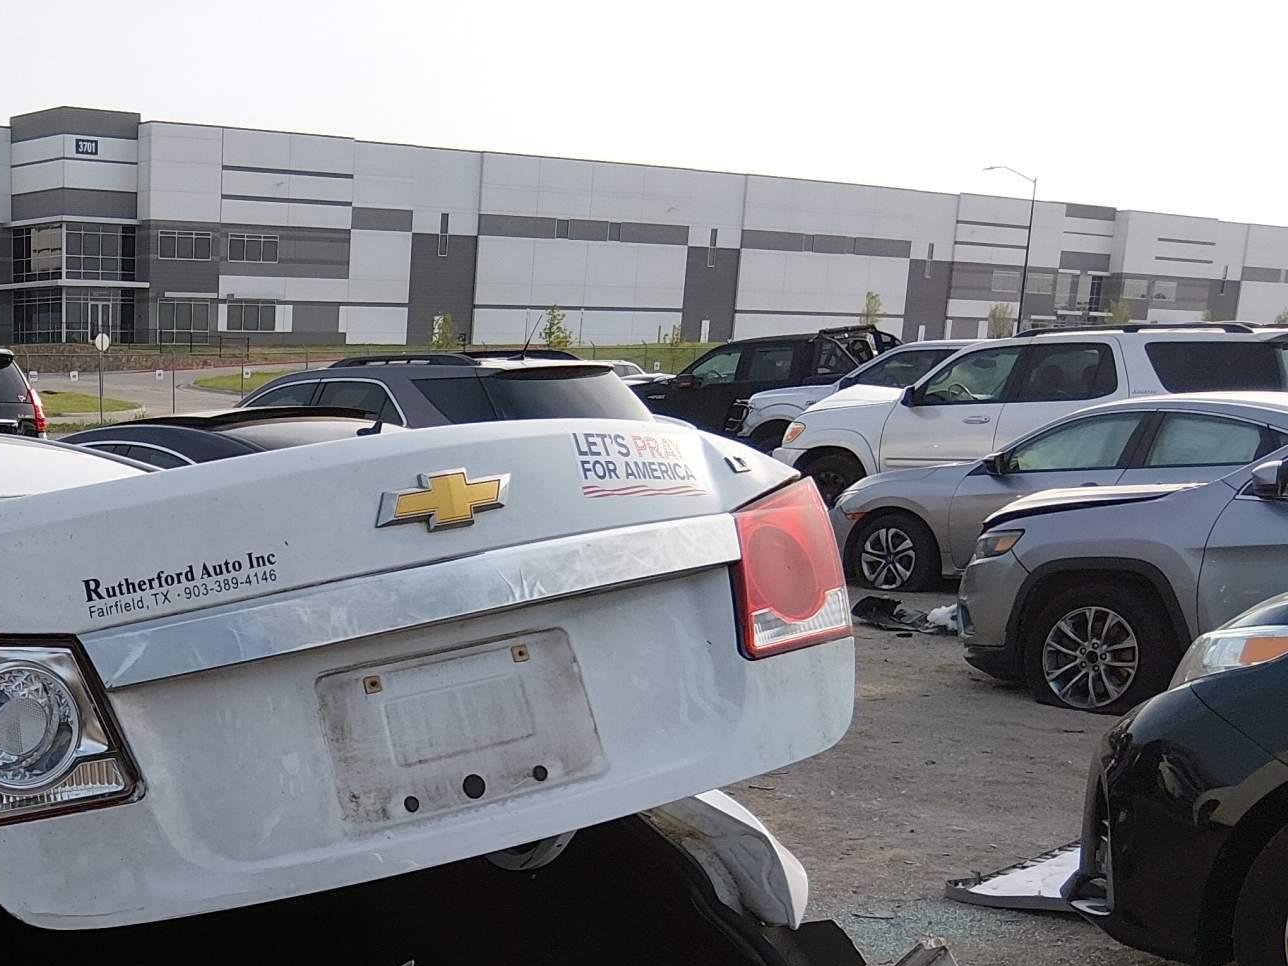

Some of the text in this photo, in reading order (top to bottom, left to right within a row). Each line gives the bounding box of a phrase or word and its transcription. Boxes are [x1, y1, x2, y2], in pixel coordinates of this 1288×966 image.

[78, 141, 96, 153] 3701
[572, 432, 631, 458] LET'S
[580, 460, 697, 481] FOR AMERICA
[82, 552, 277, 603] Rutherford Auto Inc
[88, 597, 150, 619] Fairfield,
[153, 591, 172, 607] TX
[184, 568, 278, 600] 903-389-4146
